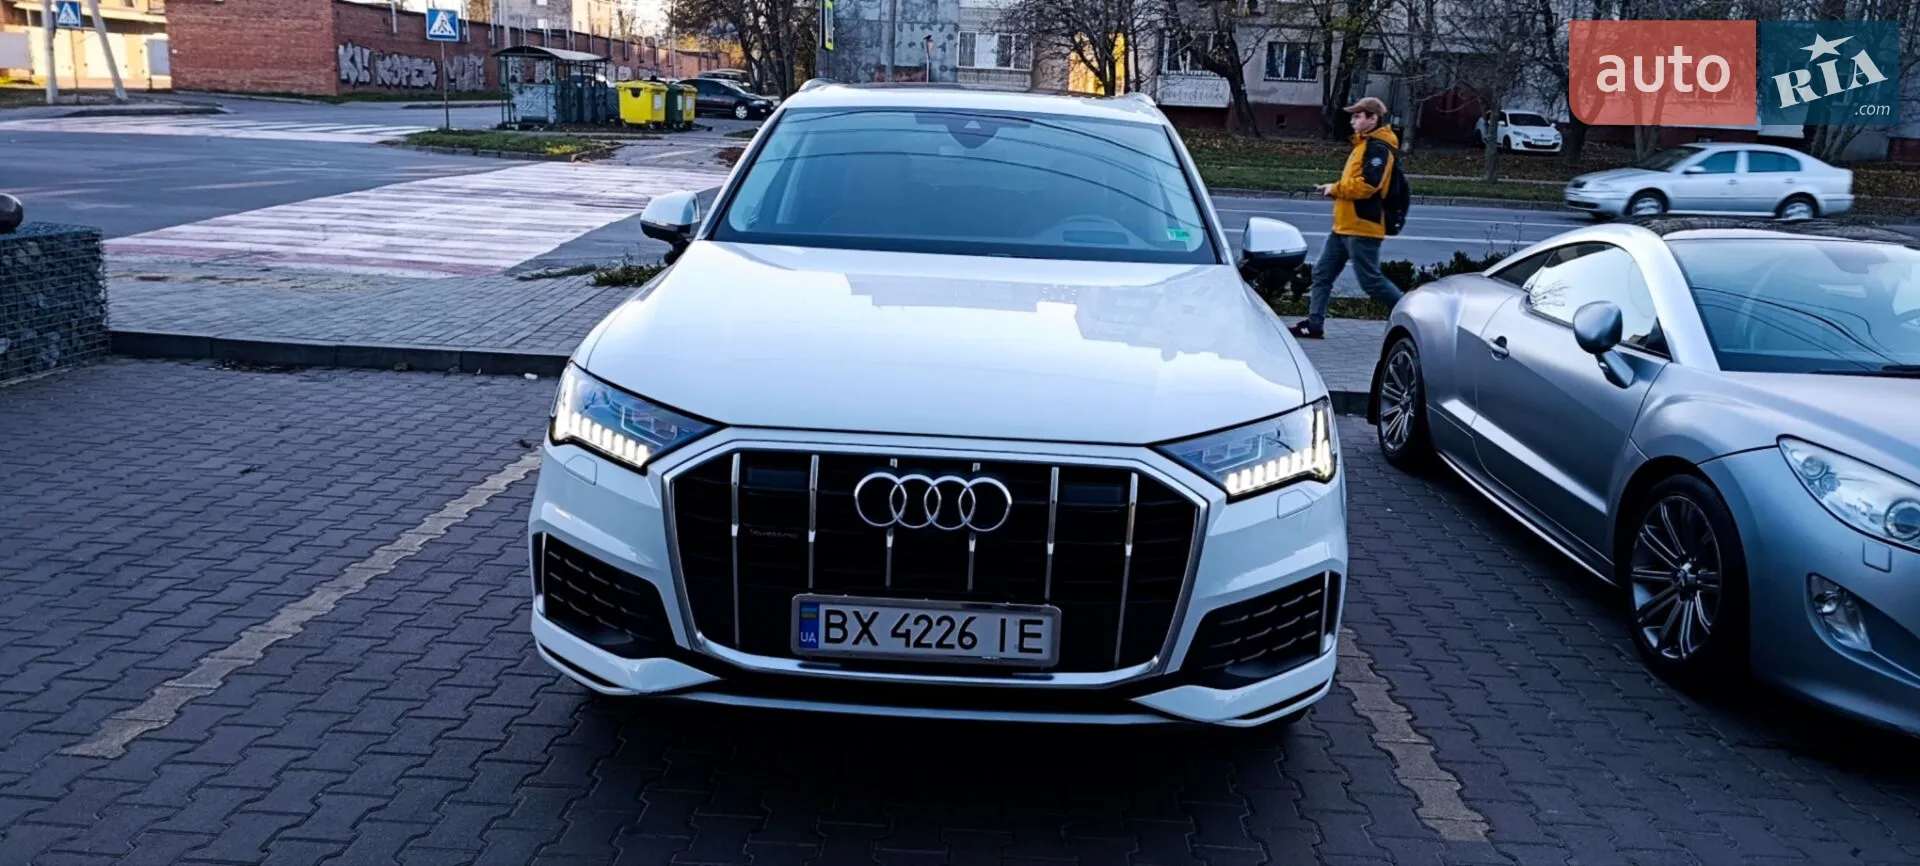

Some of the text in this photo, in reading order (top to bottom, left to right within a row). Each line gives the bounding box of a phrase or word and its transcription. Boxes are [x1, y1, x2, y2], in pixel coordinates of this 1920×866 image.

[800, 631, 817, 643] UA
[823, 608, 1044, 655] BX 4226 IE
